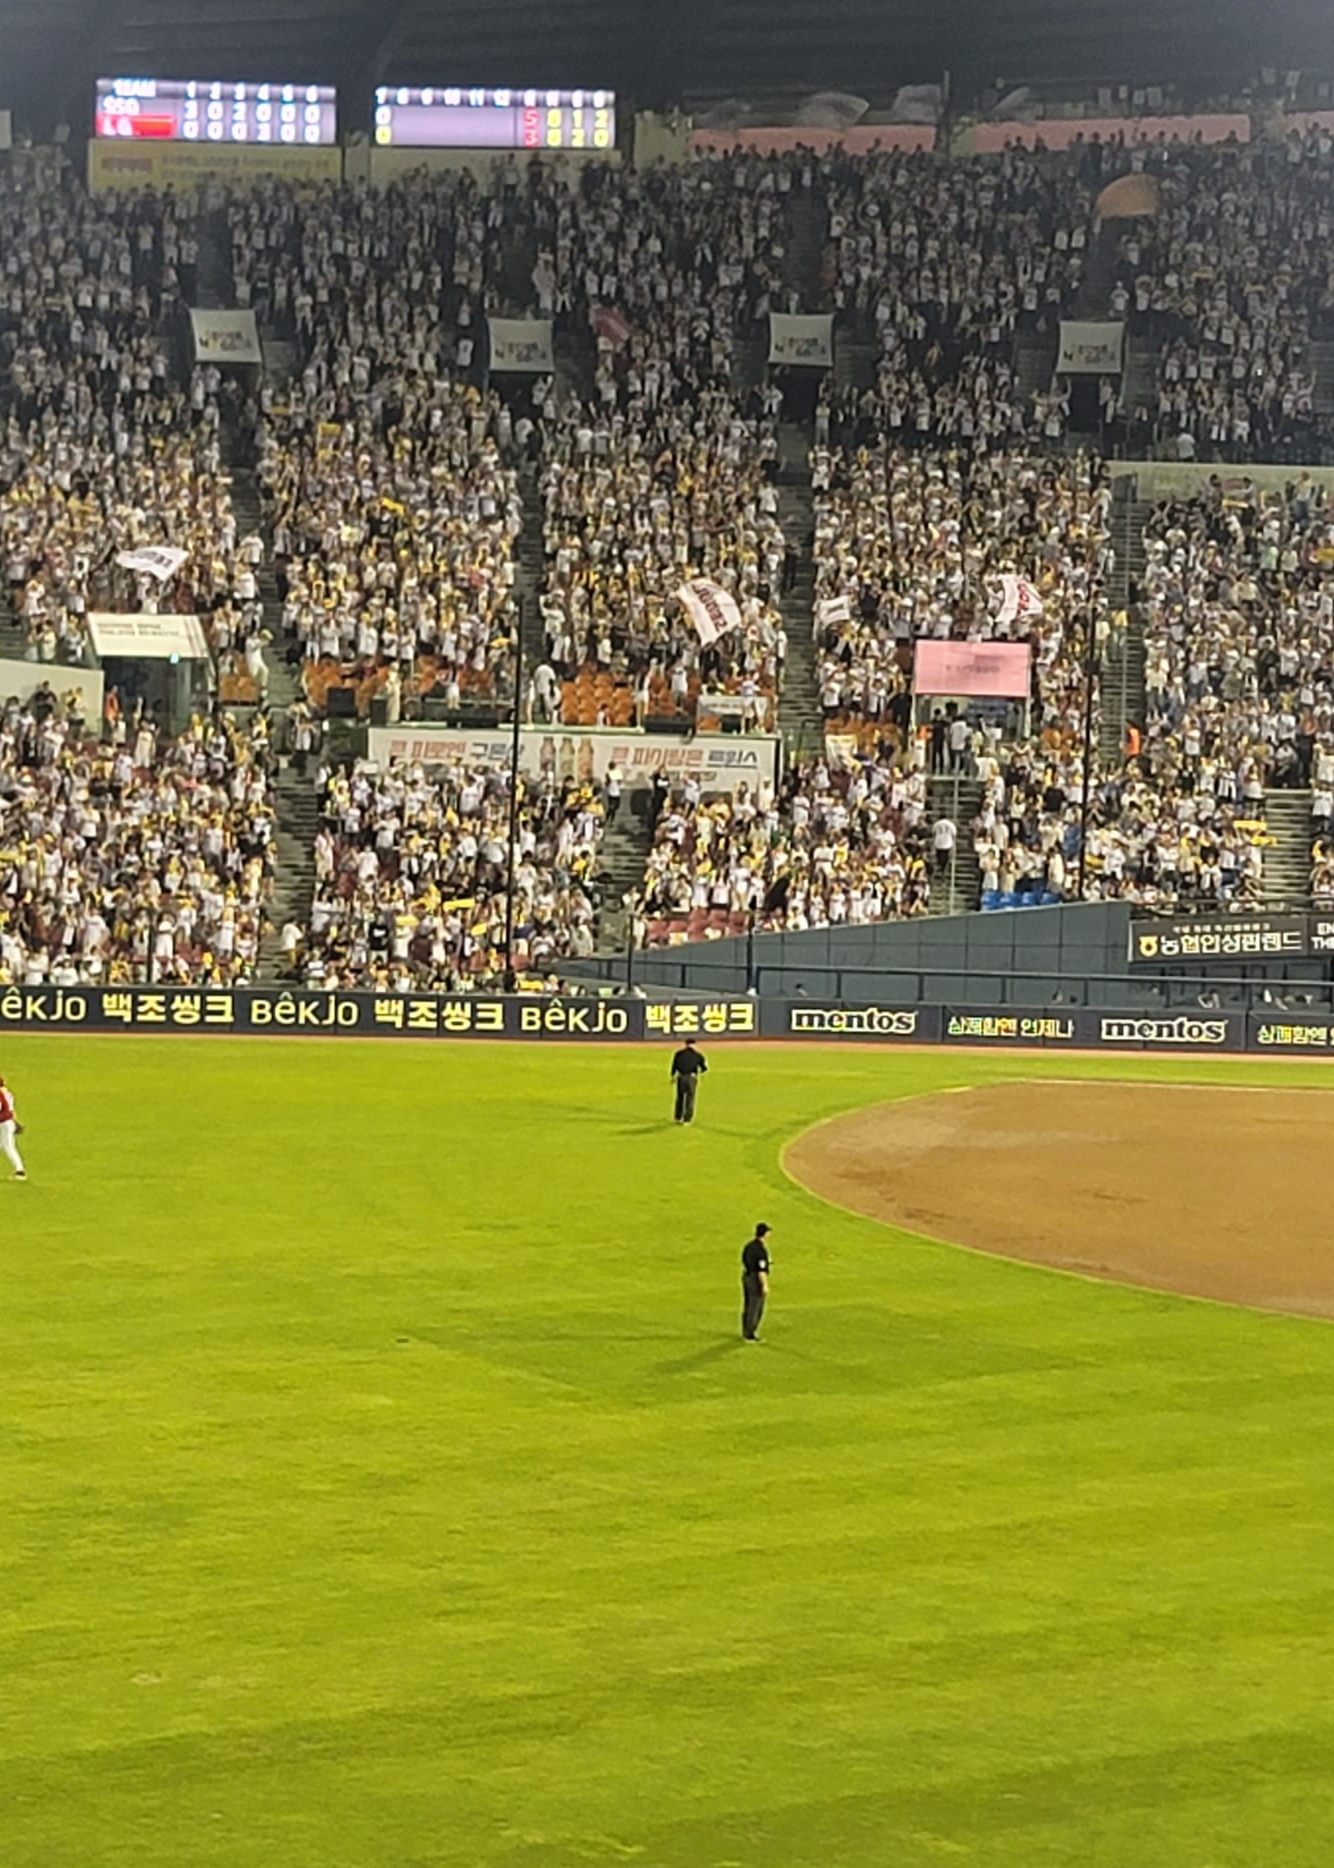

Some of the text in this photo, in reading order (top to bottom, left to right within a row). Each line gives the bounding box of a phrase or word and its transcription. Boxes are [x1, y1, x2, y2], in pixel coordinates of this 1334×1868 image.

[102, 993, 234, 1025] 백조씽크
[374, 999, 505, 1031] 백조씽크
[645, 1003, 754, 1034] 백조씽크
[791, 1008, 917, 1034] mentos
[1101, 1017, 1227, 1043] mentos
